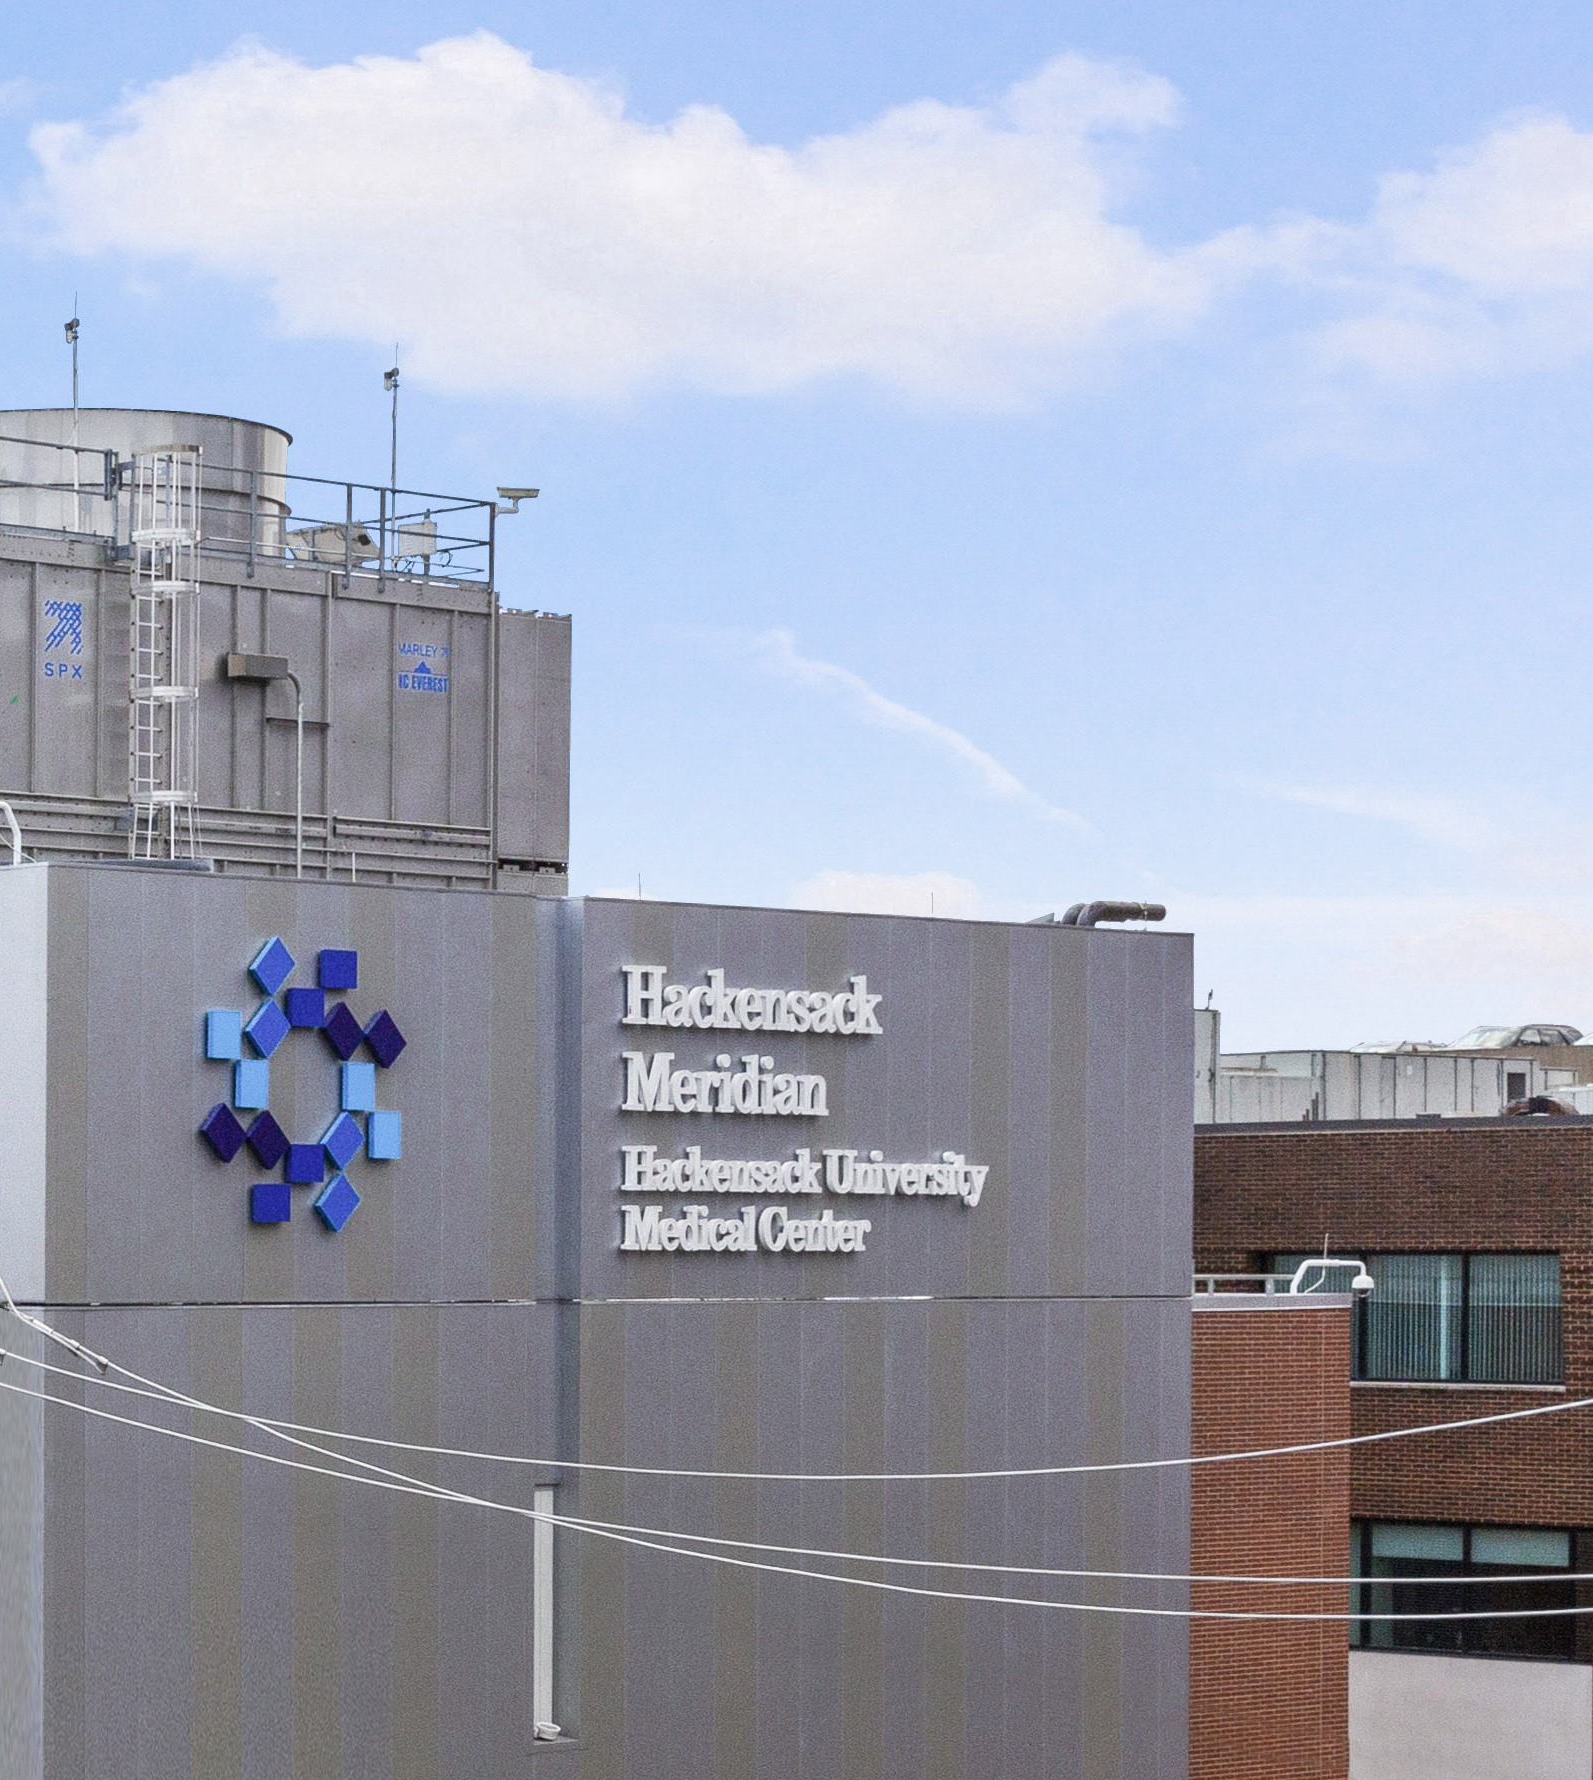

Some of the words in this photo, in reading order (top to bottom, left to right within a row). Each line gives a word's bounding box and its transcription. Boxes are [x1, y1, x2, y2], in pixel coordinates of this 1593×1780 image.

[44, 661, 82, 680] SPX
[411, 675, 448, 693] EVEREST
[621, 965, 883, 1034] Hackensack
[621, 1051, 829, 1116] Meridian
[621, 1145, 822, 1193] Hackensack
[823, 1149, 989, 1206] University
[621, 1205, 757, 1251] Medical
[758, 1206, 871, 1252] Center
